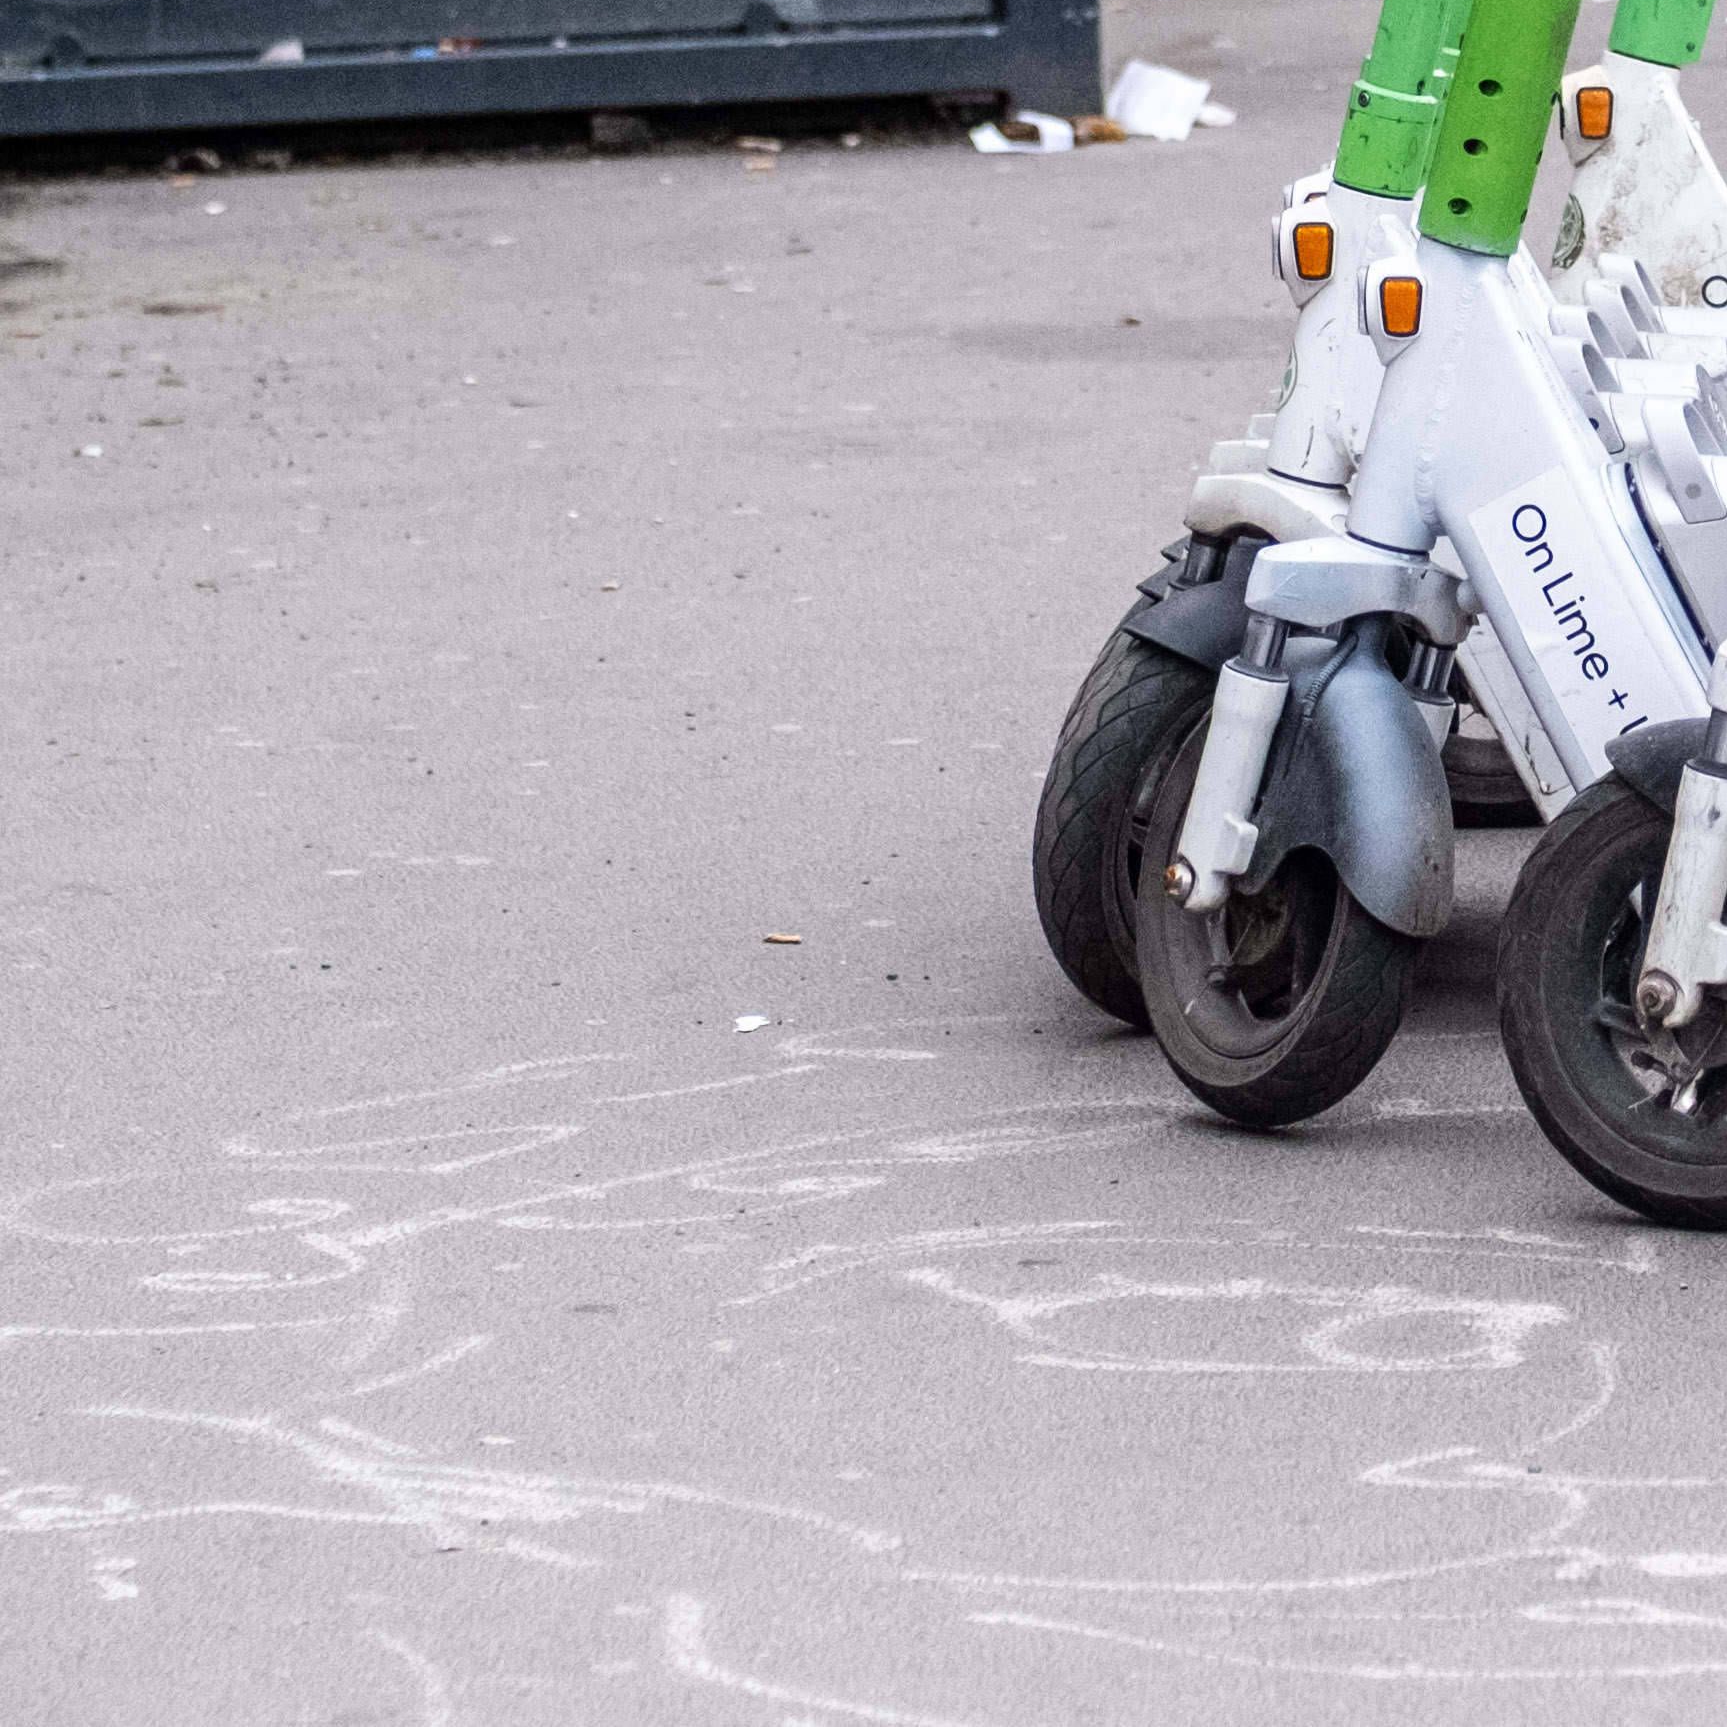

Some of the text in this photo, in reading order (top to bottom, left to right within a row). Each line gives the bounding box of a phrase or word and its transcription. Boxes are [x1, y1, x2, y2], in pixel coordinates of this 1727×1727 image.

[1512, 504, 1628, 710] On Lime +
